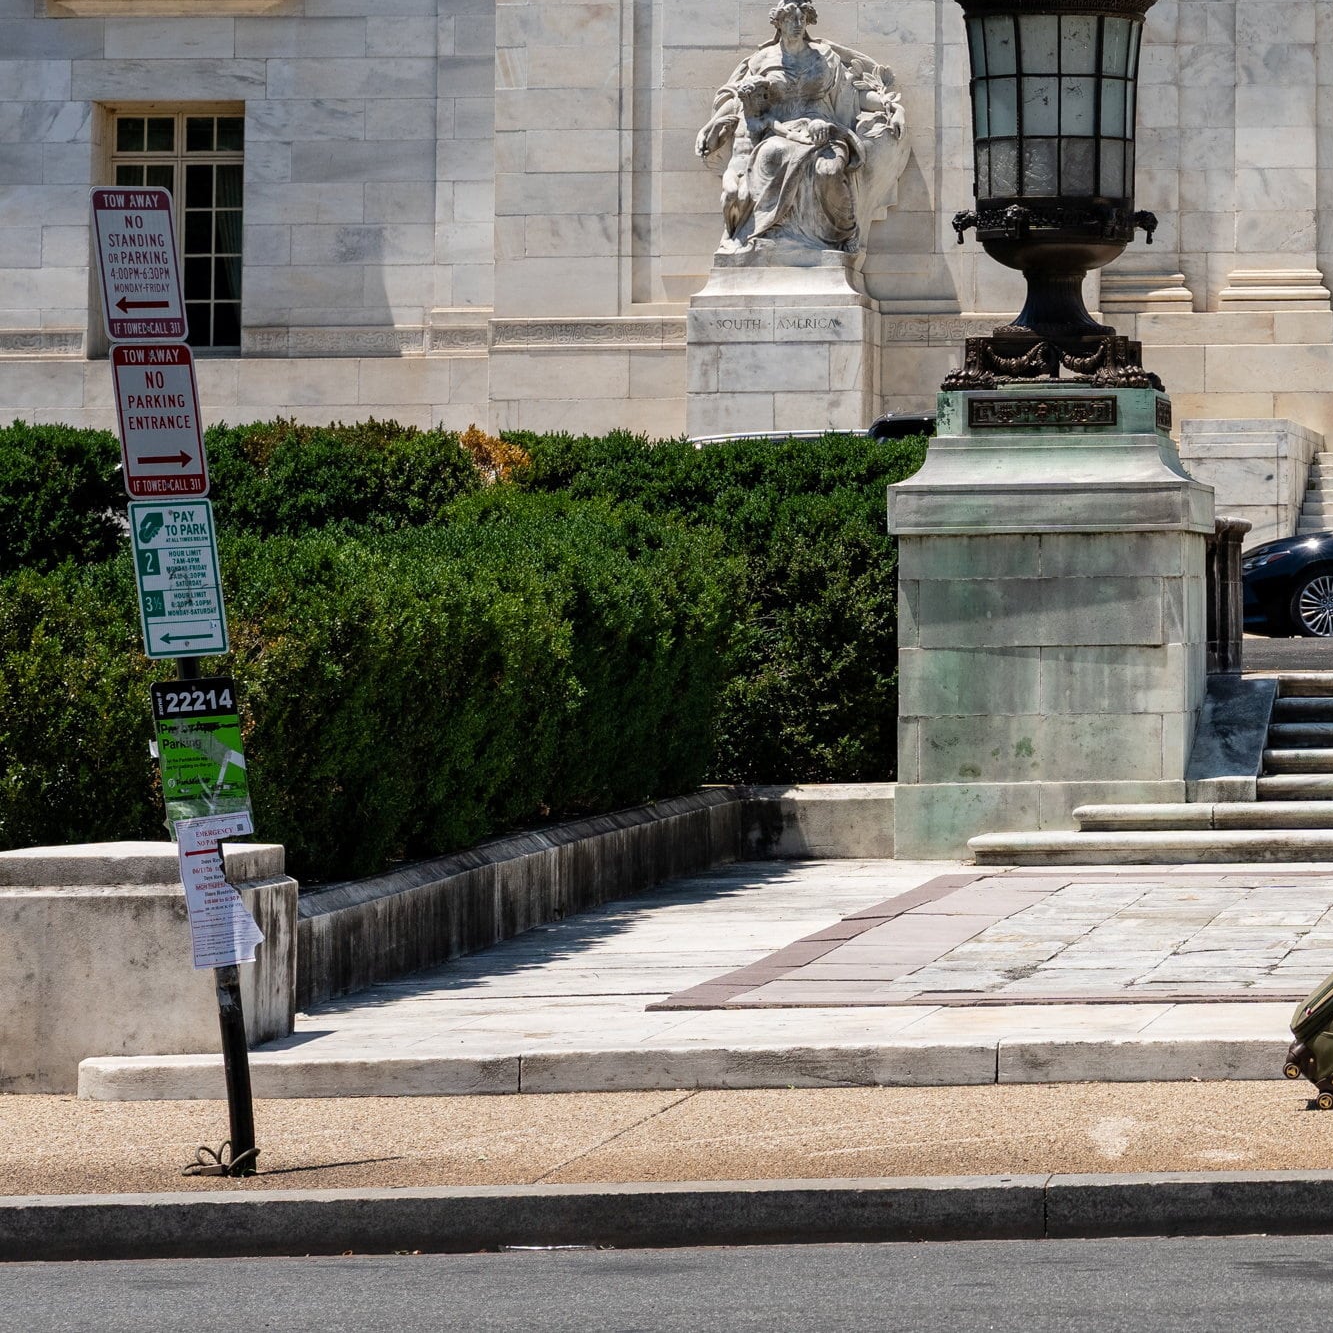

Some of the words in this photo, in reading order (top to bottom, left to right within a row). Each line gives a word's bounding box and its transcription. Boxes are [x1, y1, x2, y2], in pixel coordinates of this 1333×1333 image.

[103, 194, 124, 208] TOW
[130, 194, 158, 208] AWAY
[124, 215, 143, 228] NO
[108, 233, 165, 248] STANDING
[108, 253, 118, 263] OR
[121, 251, 168, 265] PARKING
[110, 268, 170, 280] 4:00PM-6:30PM
[114, 283, 170, 293] MONDAY-FRIDAY
[114, 323, 121, 334] IF
[123, 323, 147, 334] TOWED
[150, 322, 168, 334] CALL
[170, 322, 180, 333] 311
[123, 350, 144, 363] TOW
[150, 349, 179, 362] AWAY
[144, 371, 164, 389] NO
[128, 394, 185, 409] PARKING
[129, 415, 191, 430] ENTRANCE
[133, 481, 140, 492] IF
[142, 480, 166, 492] TOWED
[170, 479, 188, 491] CALL
[190, 479, 200, 490] 311
[173, 511, 195, 523] PAY
[165, 525, 177, 536] TO
[180, 523, 207, 535] PARK
[145, 552, 154, 572] 2
[166, 689, 232, 712] 22214
[163, 739, 201, 749] Parking
[196, 827, 233, 837] EMERGENCY
